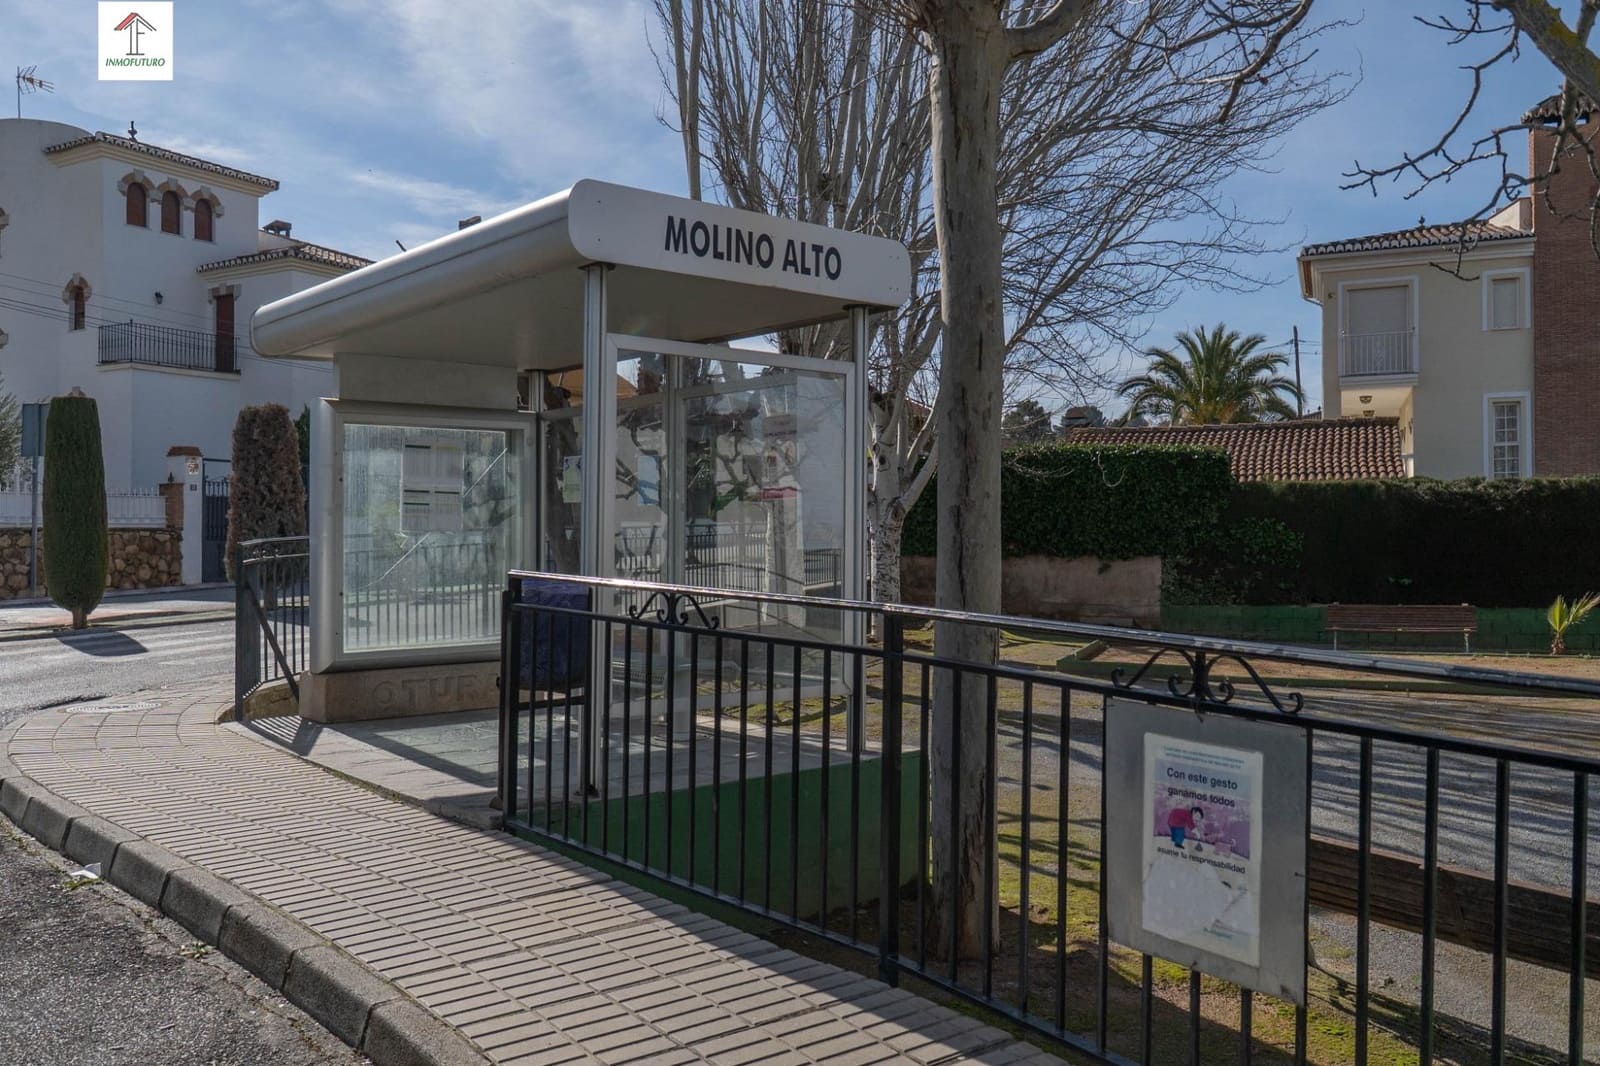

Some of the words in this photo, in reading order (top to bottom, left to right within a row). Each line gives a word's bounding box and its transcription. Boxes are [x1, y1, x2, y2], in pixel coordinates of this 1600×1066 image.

[664, 215, 775, 269] MOLINO
[782, 239, 842, 281] ALTO
[1166, 767, 1186, 780] Con
[1188, 774, 1208, 785] este
[1210, 777, 1238, 790] gesto
[1167, 786, 1207, 802] ganamos
[1210, 795, 1235, 808] todos
